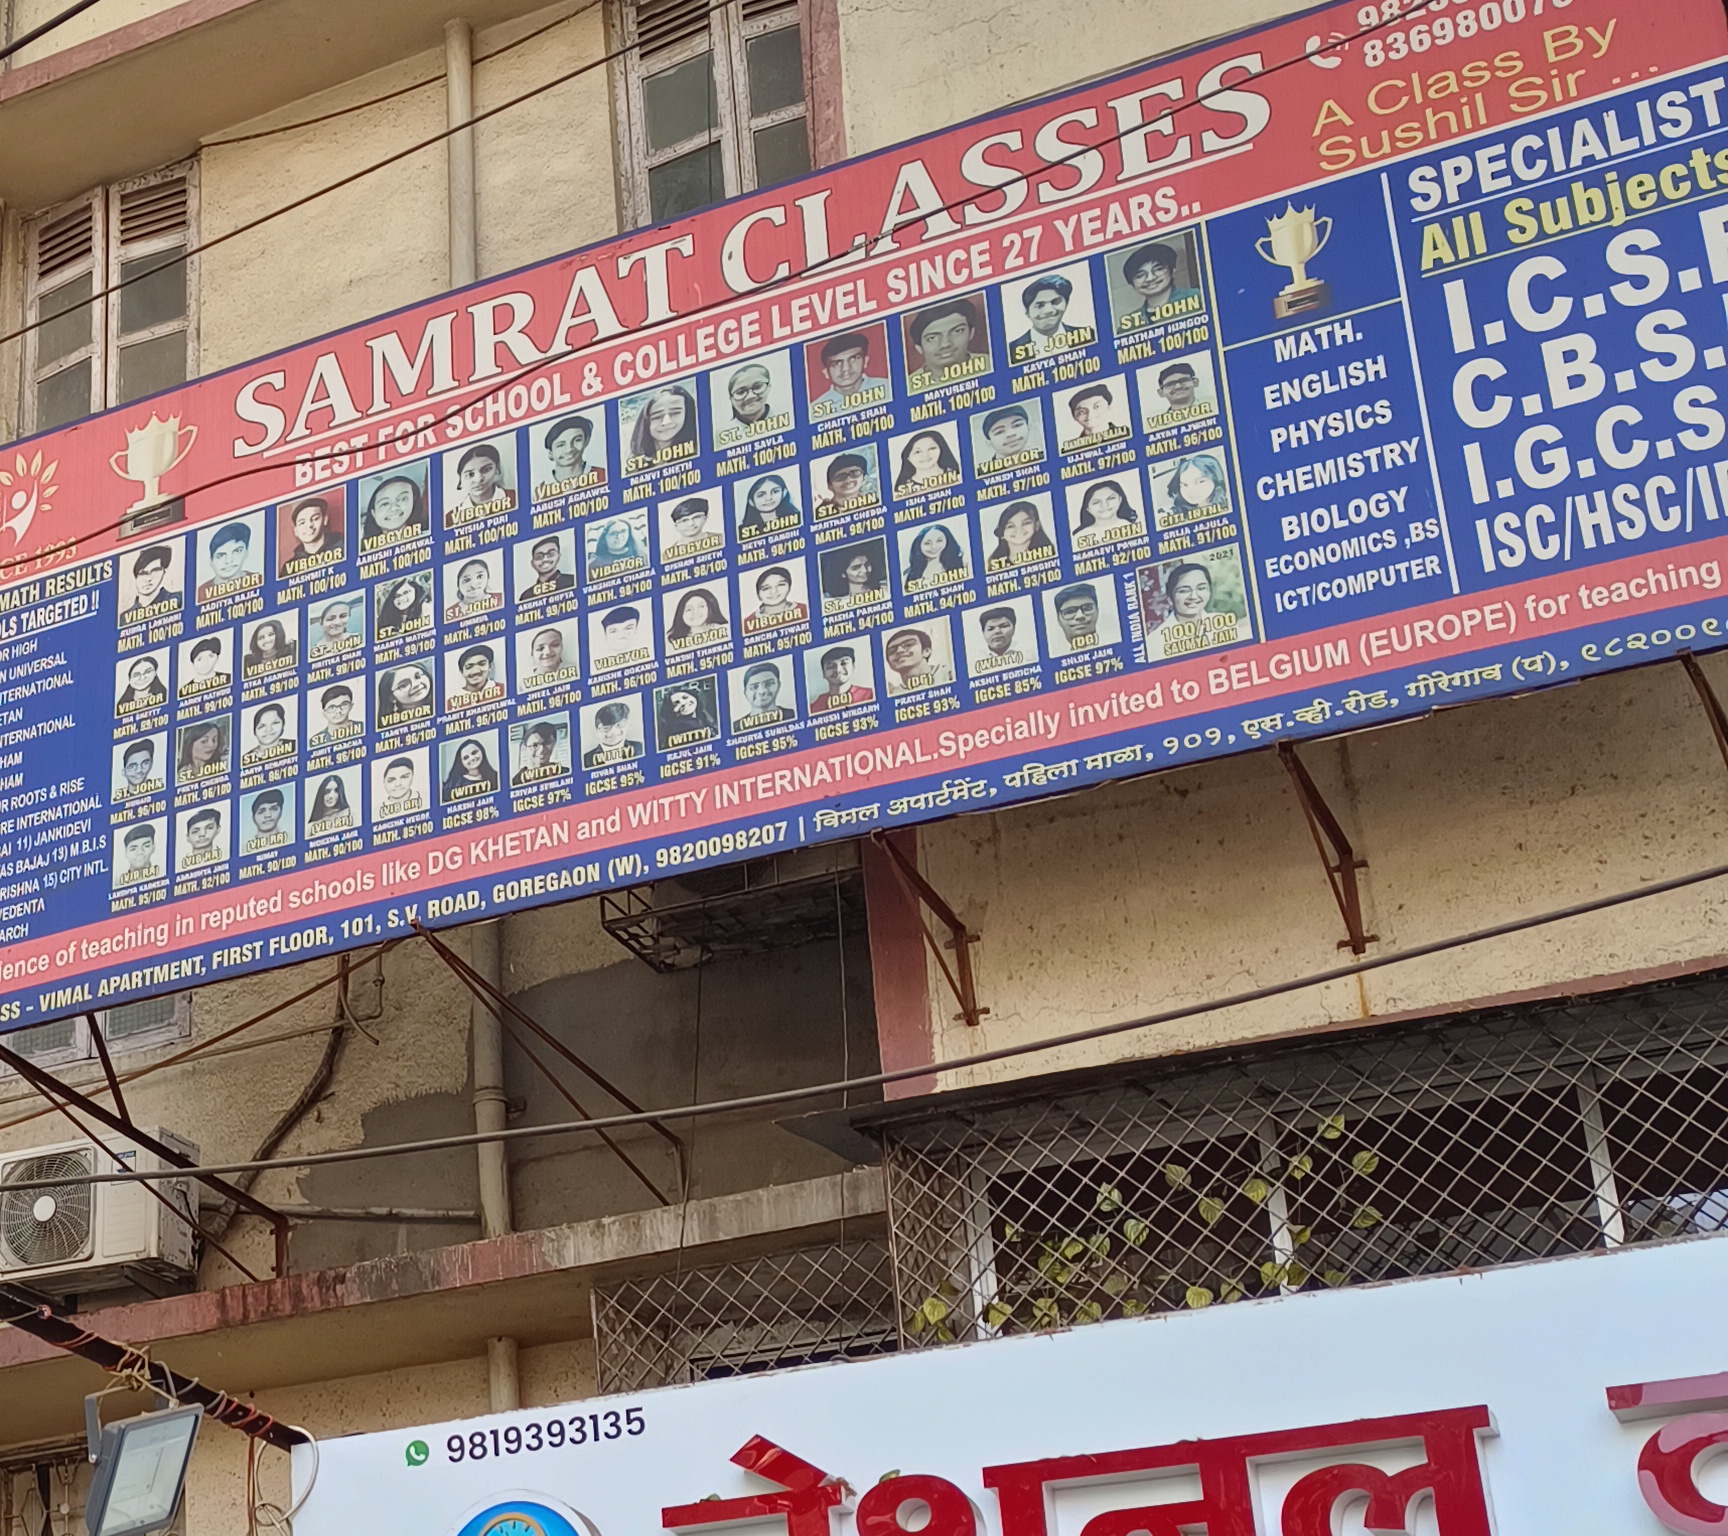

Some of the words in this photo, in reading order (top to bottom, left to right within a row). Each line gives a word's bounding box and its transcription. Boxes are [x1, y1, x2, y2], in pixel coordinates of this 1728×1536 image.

[1312, 98, 1355, 137] A
[1368, 50, 1525, 117] Class
[1543, 18, 1618, 64] By
[1318, 92, 1489, 172] Sushil
[1508, 67, 1586, 114] Sir
[1408, 77, 1727, 213] SPECIALIST
[1421, 212, 1488, 271] All
[1504, 147, 1728, 245] Subjects
[233, 236, 695, 459] SAMRAT
[721, 51, 1272, 298] CLASSES
[1151, 295, 1200, 322] JOHN
[295, 431, 368, 488] BEST
[378, 413, 439, 462] FOR
[445, 370, 572, 440] SCHOOL
[613, 307, 762, 387] COLLEGE
[772, 274, 876, 327] LEVEL
[887, 241, 993, 303] SINCE
[1002, 225, 1044, 266] 27
[1160, 326, 1209, 354] 100/100
[1273, 319, 1364, 363] MATH.
[1263, 354, 1388, 410] ENGLISH
[1270, 399, 1393, 453] PHYSICS
[1256, 436, 1421, 502] CHEMISTRY
[1280, 486, 1410, 542] BIOLOGY
[45, 560, 113, 599] RESULTS
[1265, 528, 1398, 579] ECONOMICS
[20, 594, 87, 631] TARGETED
[1275, 555, 1443, 613] ICT/COMPUTER
[1160, 612, 1238, 642] 100/100
[55, 942, 77, 968] of
[81, 920, 169, 962] teaching
[175, 913, 195, 937] in
[200, 890, 283, 936] reputed
[287, 869, 375, 918] schools
[381, 860, 421, 888] like
[428, 846, 464, 877] DG
[469, 820, 570, 865] KHETAN
[576, 809, 621, 841] and
[627, 788, 712, 830] WITTY
[1069, 683, 1164, 727] invited
[1171, 673, 1201, 702] to
[1207, 638, 1352, 697] BELGIUM
[1359, 602, 1518, 667] (EUROPE)
[1524, 591, 1570, 625] for
[1577, 557, 1722, 613] teaching
[814, 802, 880, 833] विमल
[1003, 756, 1078, 789] पहिला
[1406, 661, 1502, 701] गोरेगाव
[39, 982, 93, 1013] VIMAL
[98, 955, 207, 998] APARTMENT,
[212, 941, 264, 974] FIRST
[269, 925, 334, 957] FLOOR,
[428, 887, 486, 919] ROAD,
[493, 862, 600, 904] GOREGAON
[656, 821, 789, 869] 9820098207
[445, 1405, 648, 1464] 9819393135
